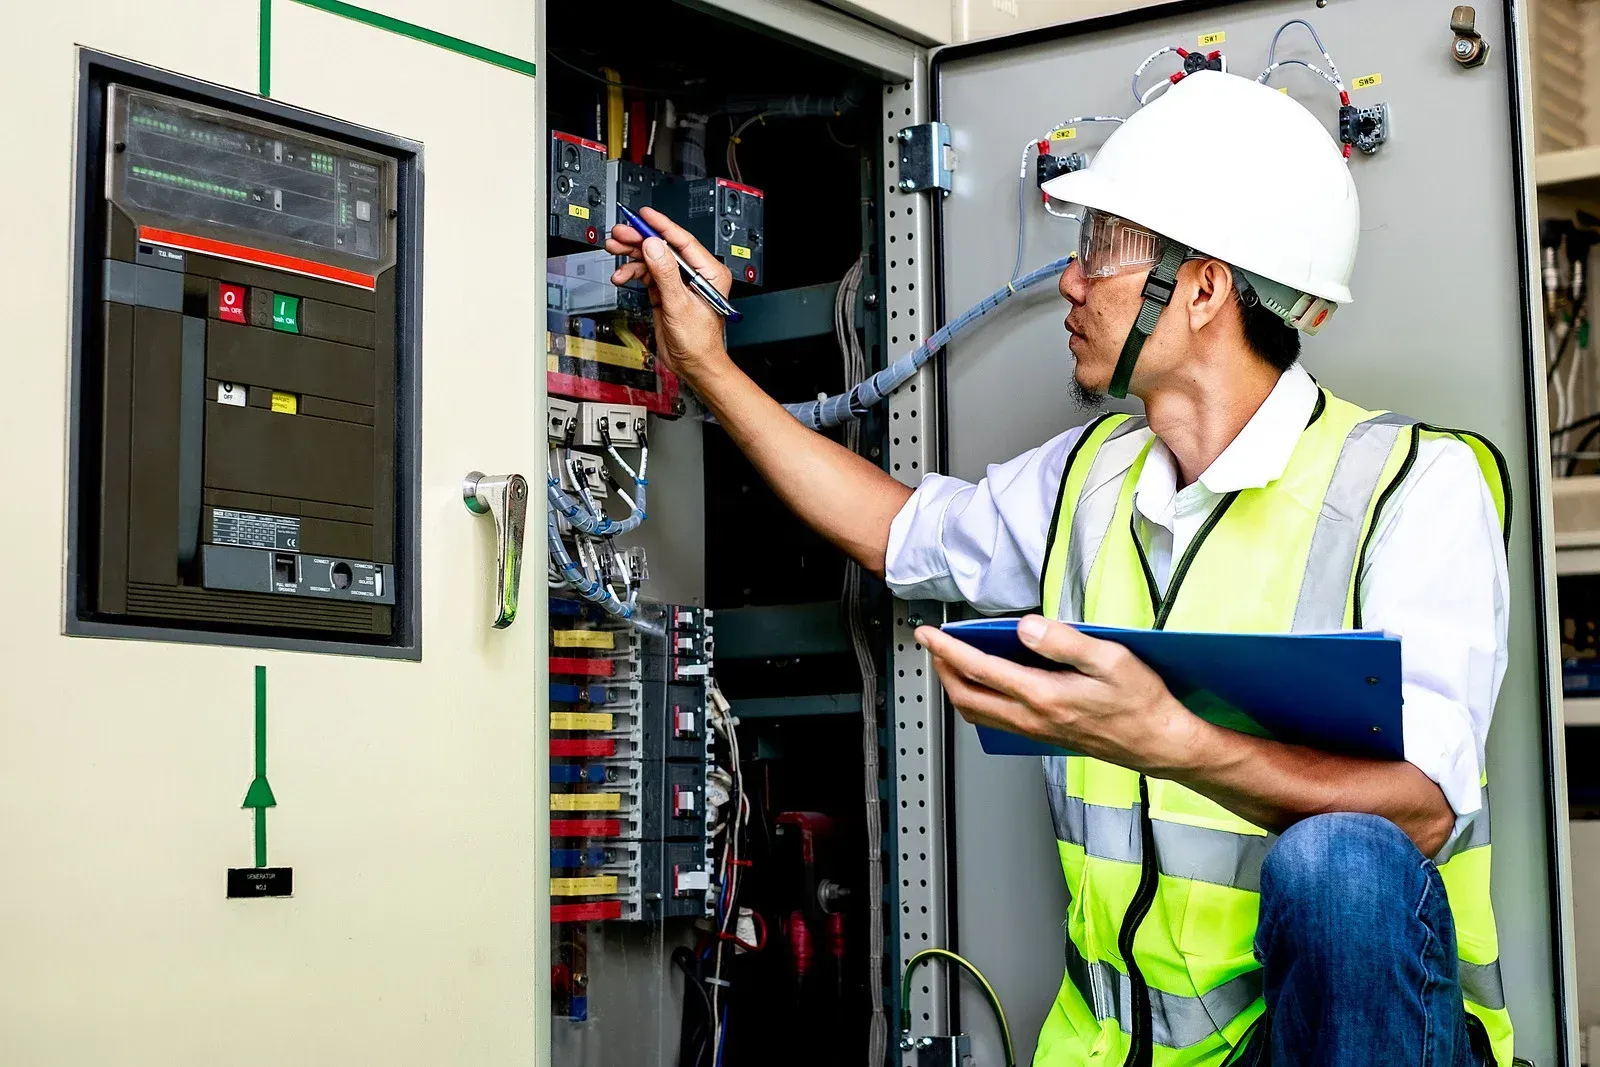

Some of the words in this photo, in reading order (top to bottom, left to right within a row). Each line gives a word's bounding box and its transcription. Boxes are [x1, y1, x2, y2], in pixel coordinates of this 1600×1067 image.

[1204, 35, 1218, 43] SW1
[1358, 76, 1375, 87] SW5
[1056, 130, 1070, 138] SW2
[285, 317, 295, 325] ON
